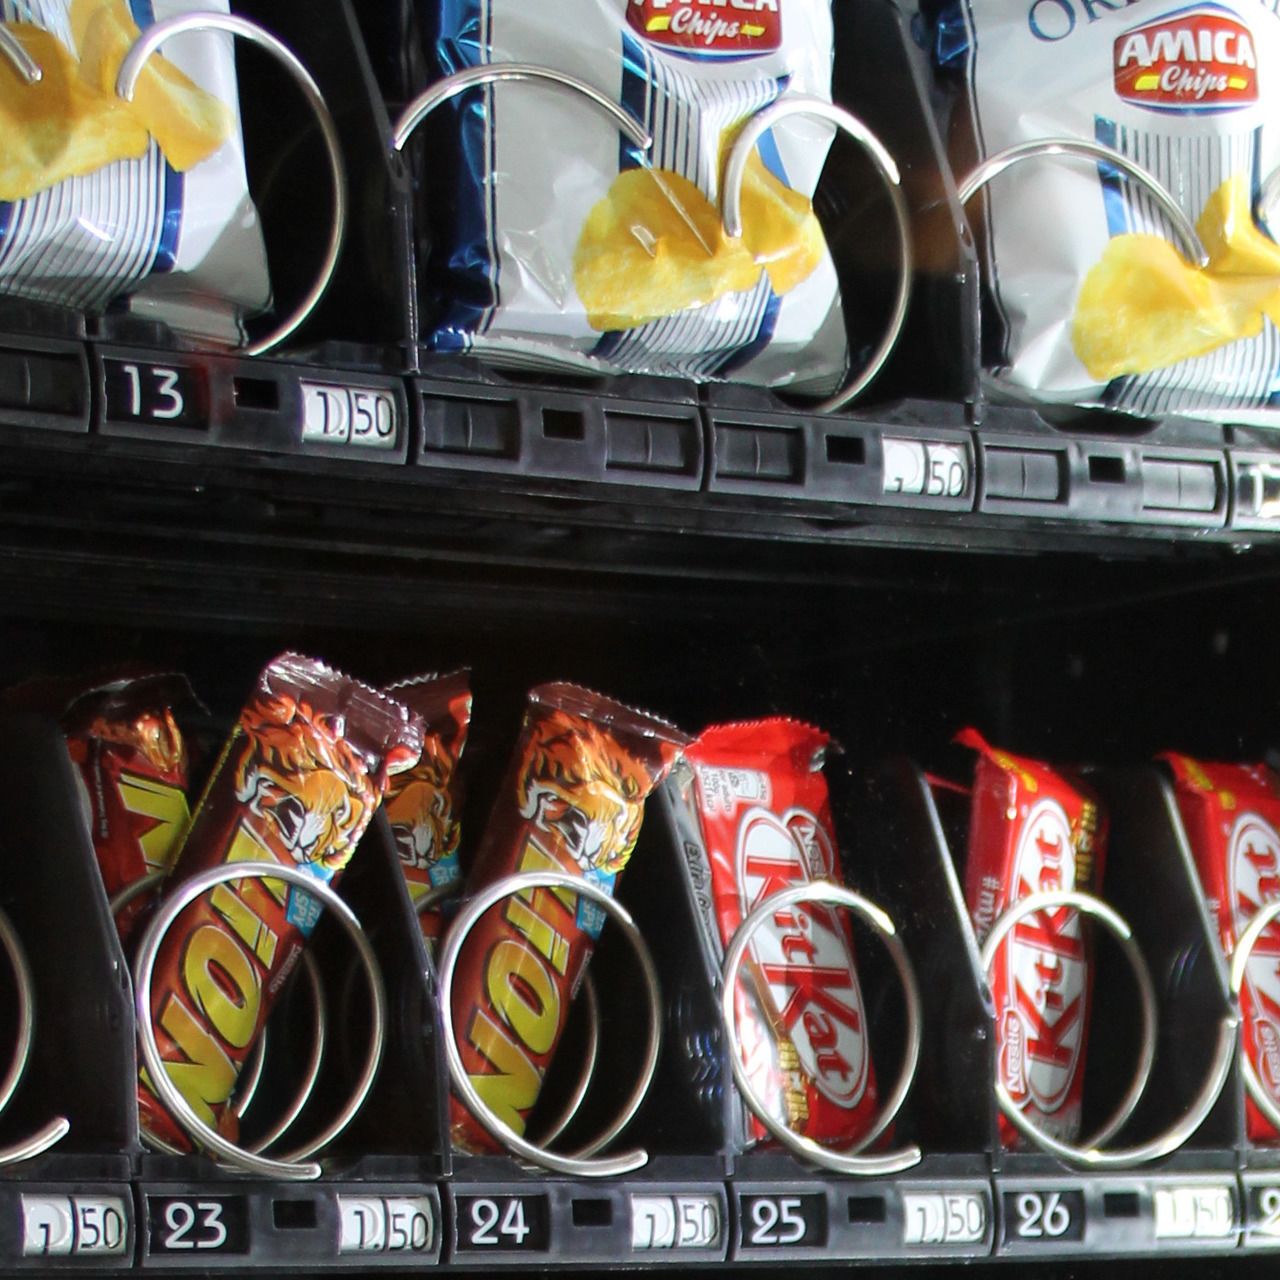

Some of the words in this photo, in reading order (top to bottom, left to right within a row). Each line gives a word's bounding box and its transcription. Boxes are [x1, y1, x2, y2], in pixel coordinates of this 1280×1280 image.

[669, 7, 741, 45] Chips
[1118, 28, 1256, 68] AMICA
[1160, 64, 1229, 100] Chips
[123, 364, 184, 420] 13
[164, 1201, 229, 1250] 23
[470, 1198, 531, 1245] 24
[750, 1199, 806, 1245] 25
[1017, 1193, 1071, 1238] 26
